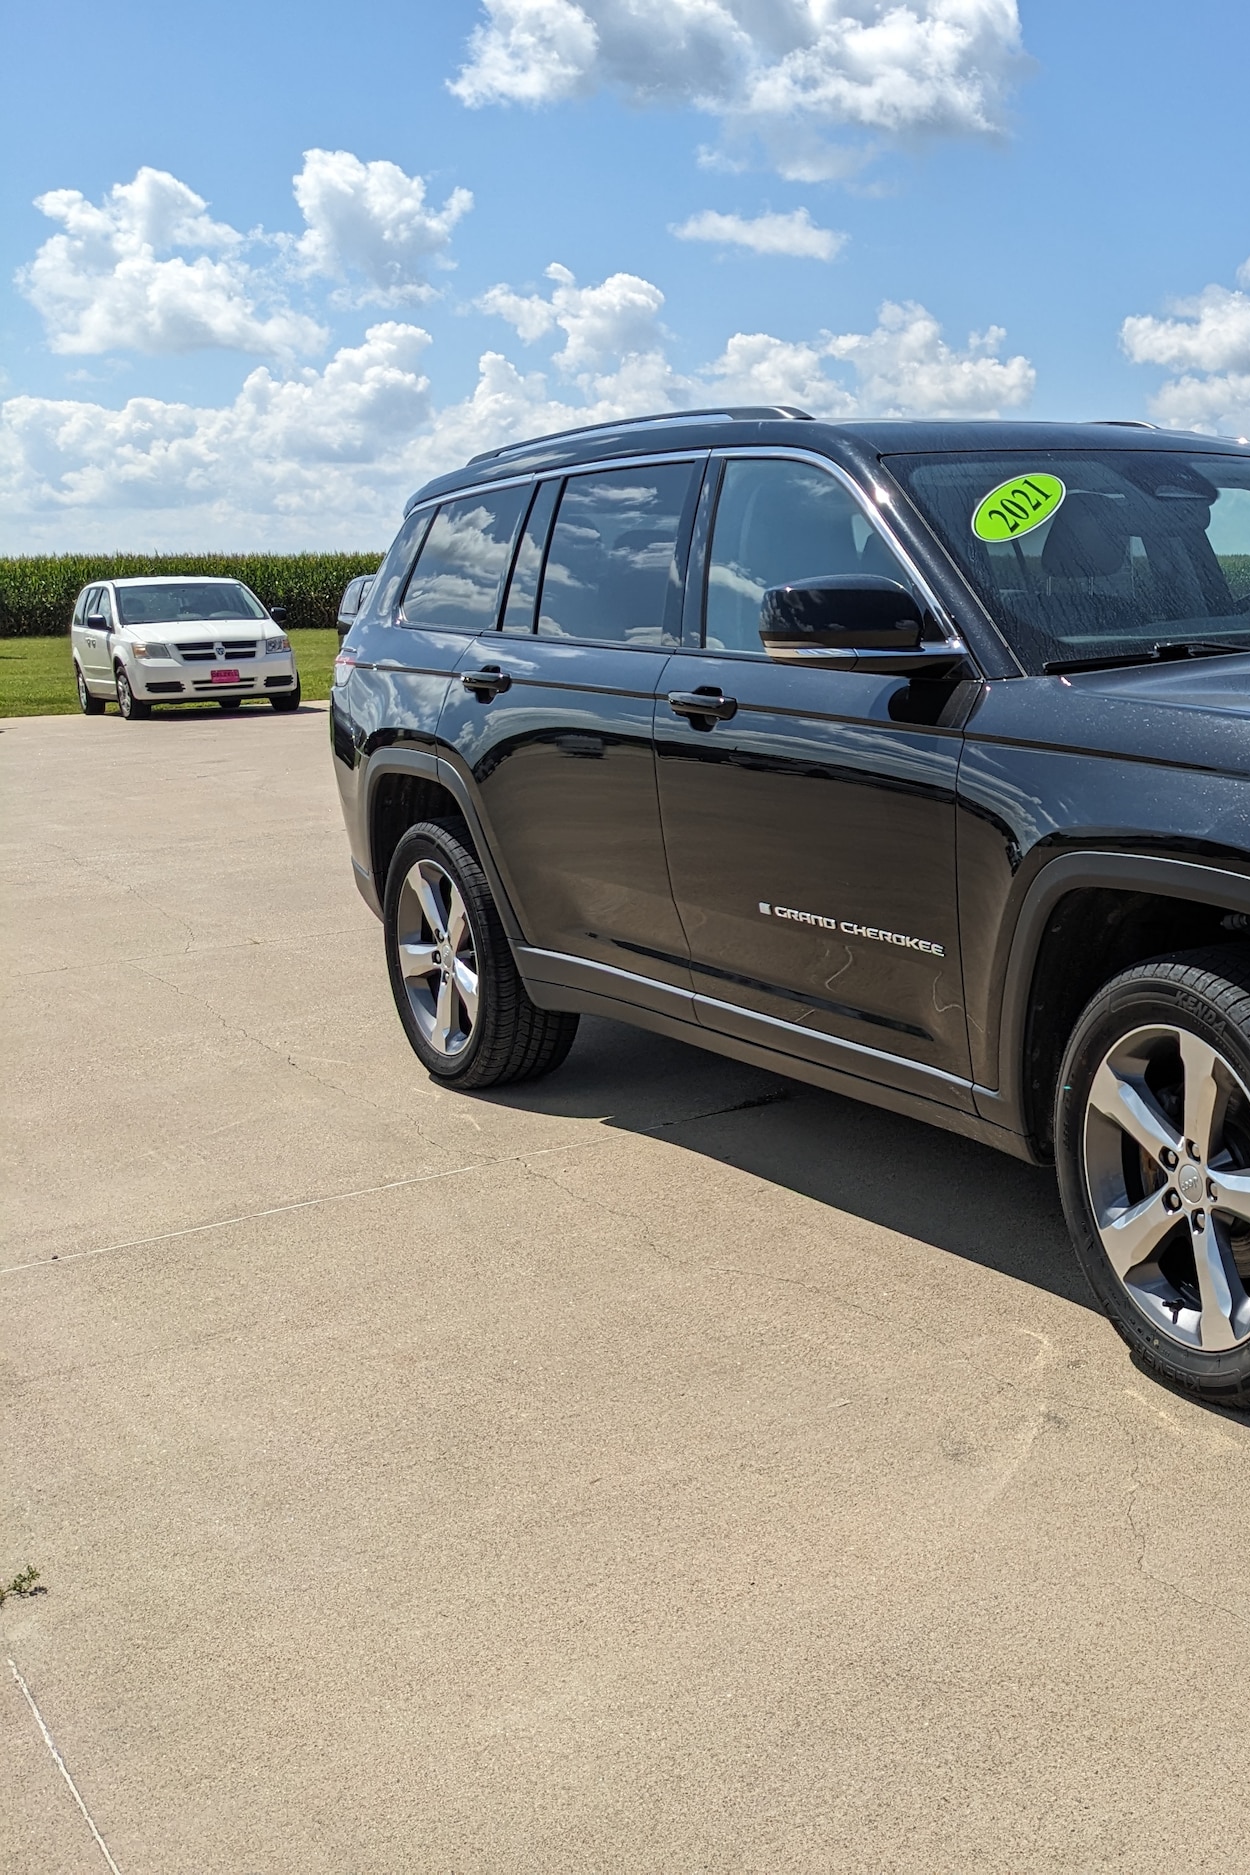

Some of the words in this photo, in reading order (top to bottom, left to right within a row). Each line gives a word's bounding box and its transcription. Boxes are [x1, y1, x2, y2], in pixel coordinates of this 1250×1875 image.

[988, 478, 1053, 534] 2021
[774, 905, 837, 931] GRAND
[840, 921, 946, 958] CHEROKEE
[1175, 990, 1228, 1037] KENDA
